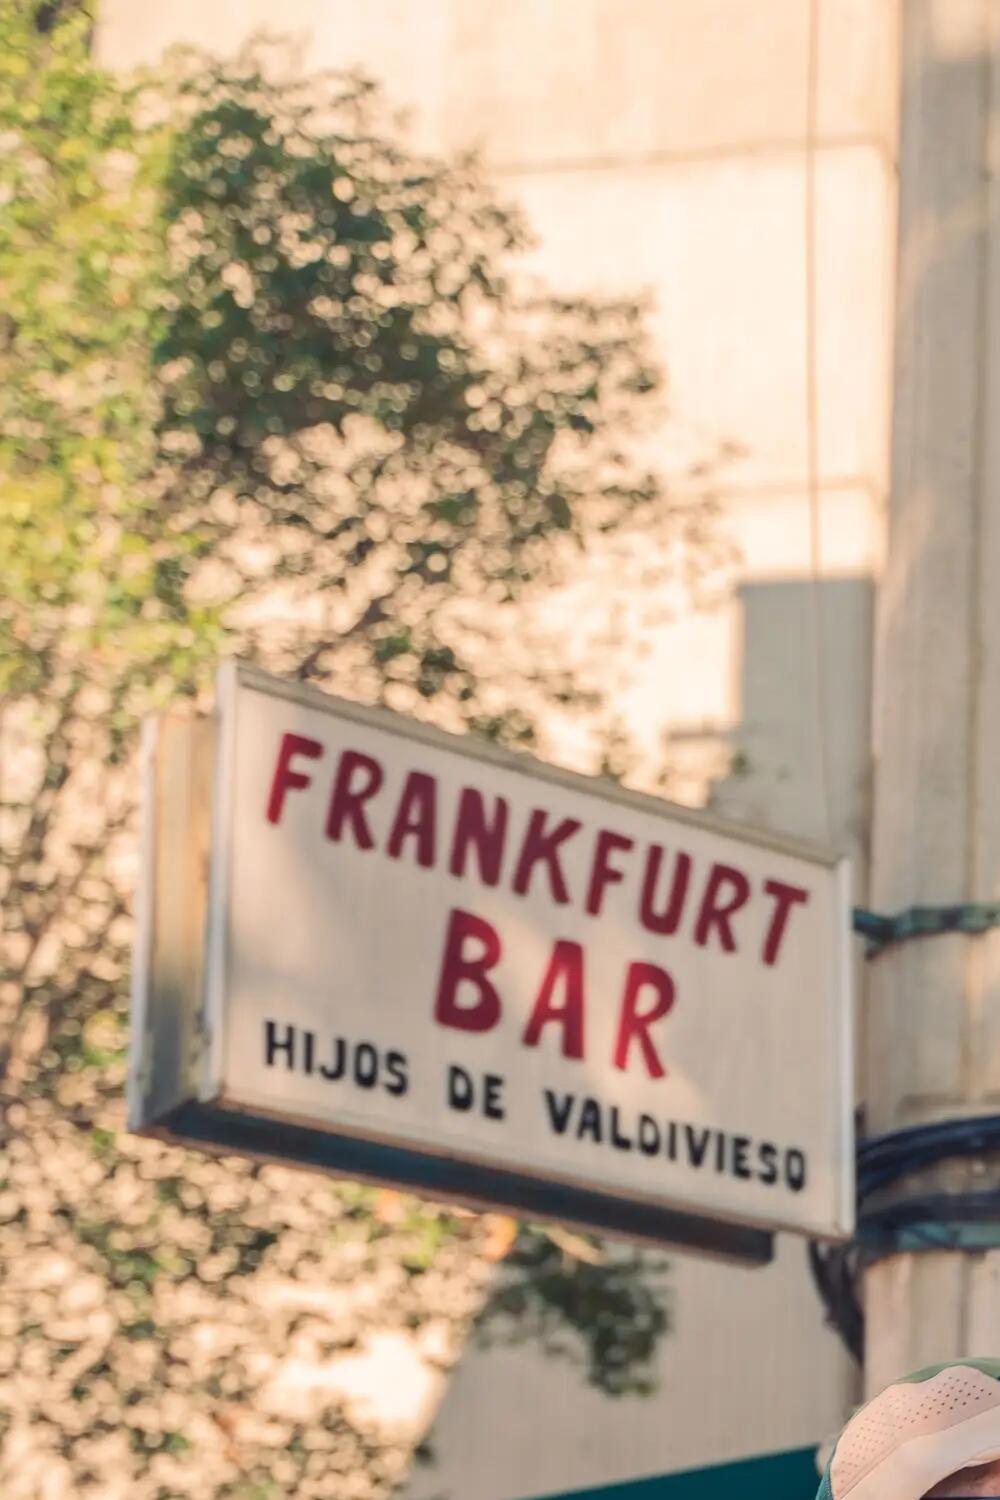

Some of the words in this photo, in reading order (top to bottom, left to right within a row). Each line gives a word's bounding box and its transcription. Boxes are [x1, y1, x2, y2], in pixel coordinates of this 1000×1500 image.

[265, 732, 810, 967] FRANKFURT
[434, 907, 677, 1080] BAR
[264, 1020, 410, 1097] HIJOS
[447, 1065, 508, 1120] DE
[543, 1089, 808, 1192] VALDIVIESO
